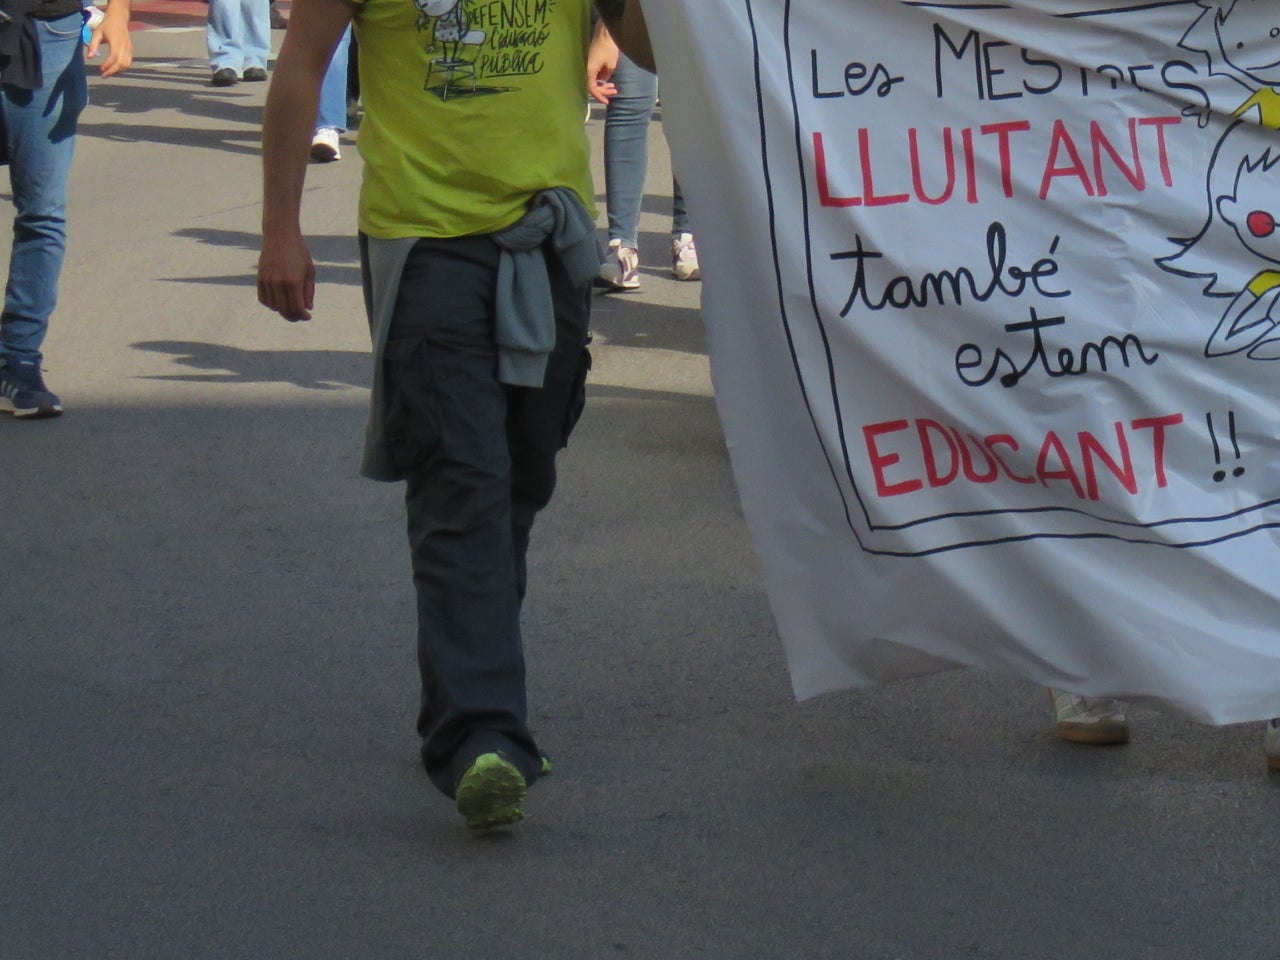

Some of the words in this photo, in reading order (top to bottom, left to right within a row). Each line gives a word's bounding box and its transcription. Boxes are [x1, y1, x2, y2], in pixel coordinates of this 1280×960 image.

[810, 48, 905, 99] Les
[811, 115, 1183, 208] LLUITANT
[829, 220, 1072, 318] també
[954, 306, 1159, 388] estem
[861, 412, 1184, 502] EDUCANT
